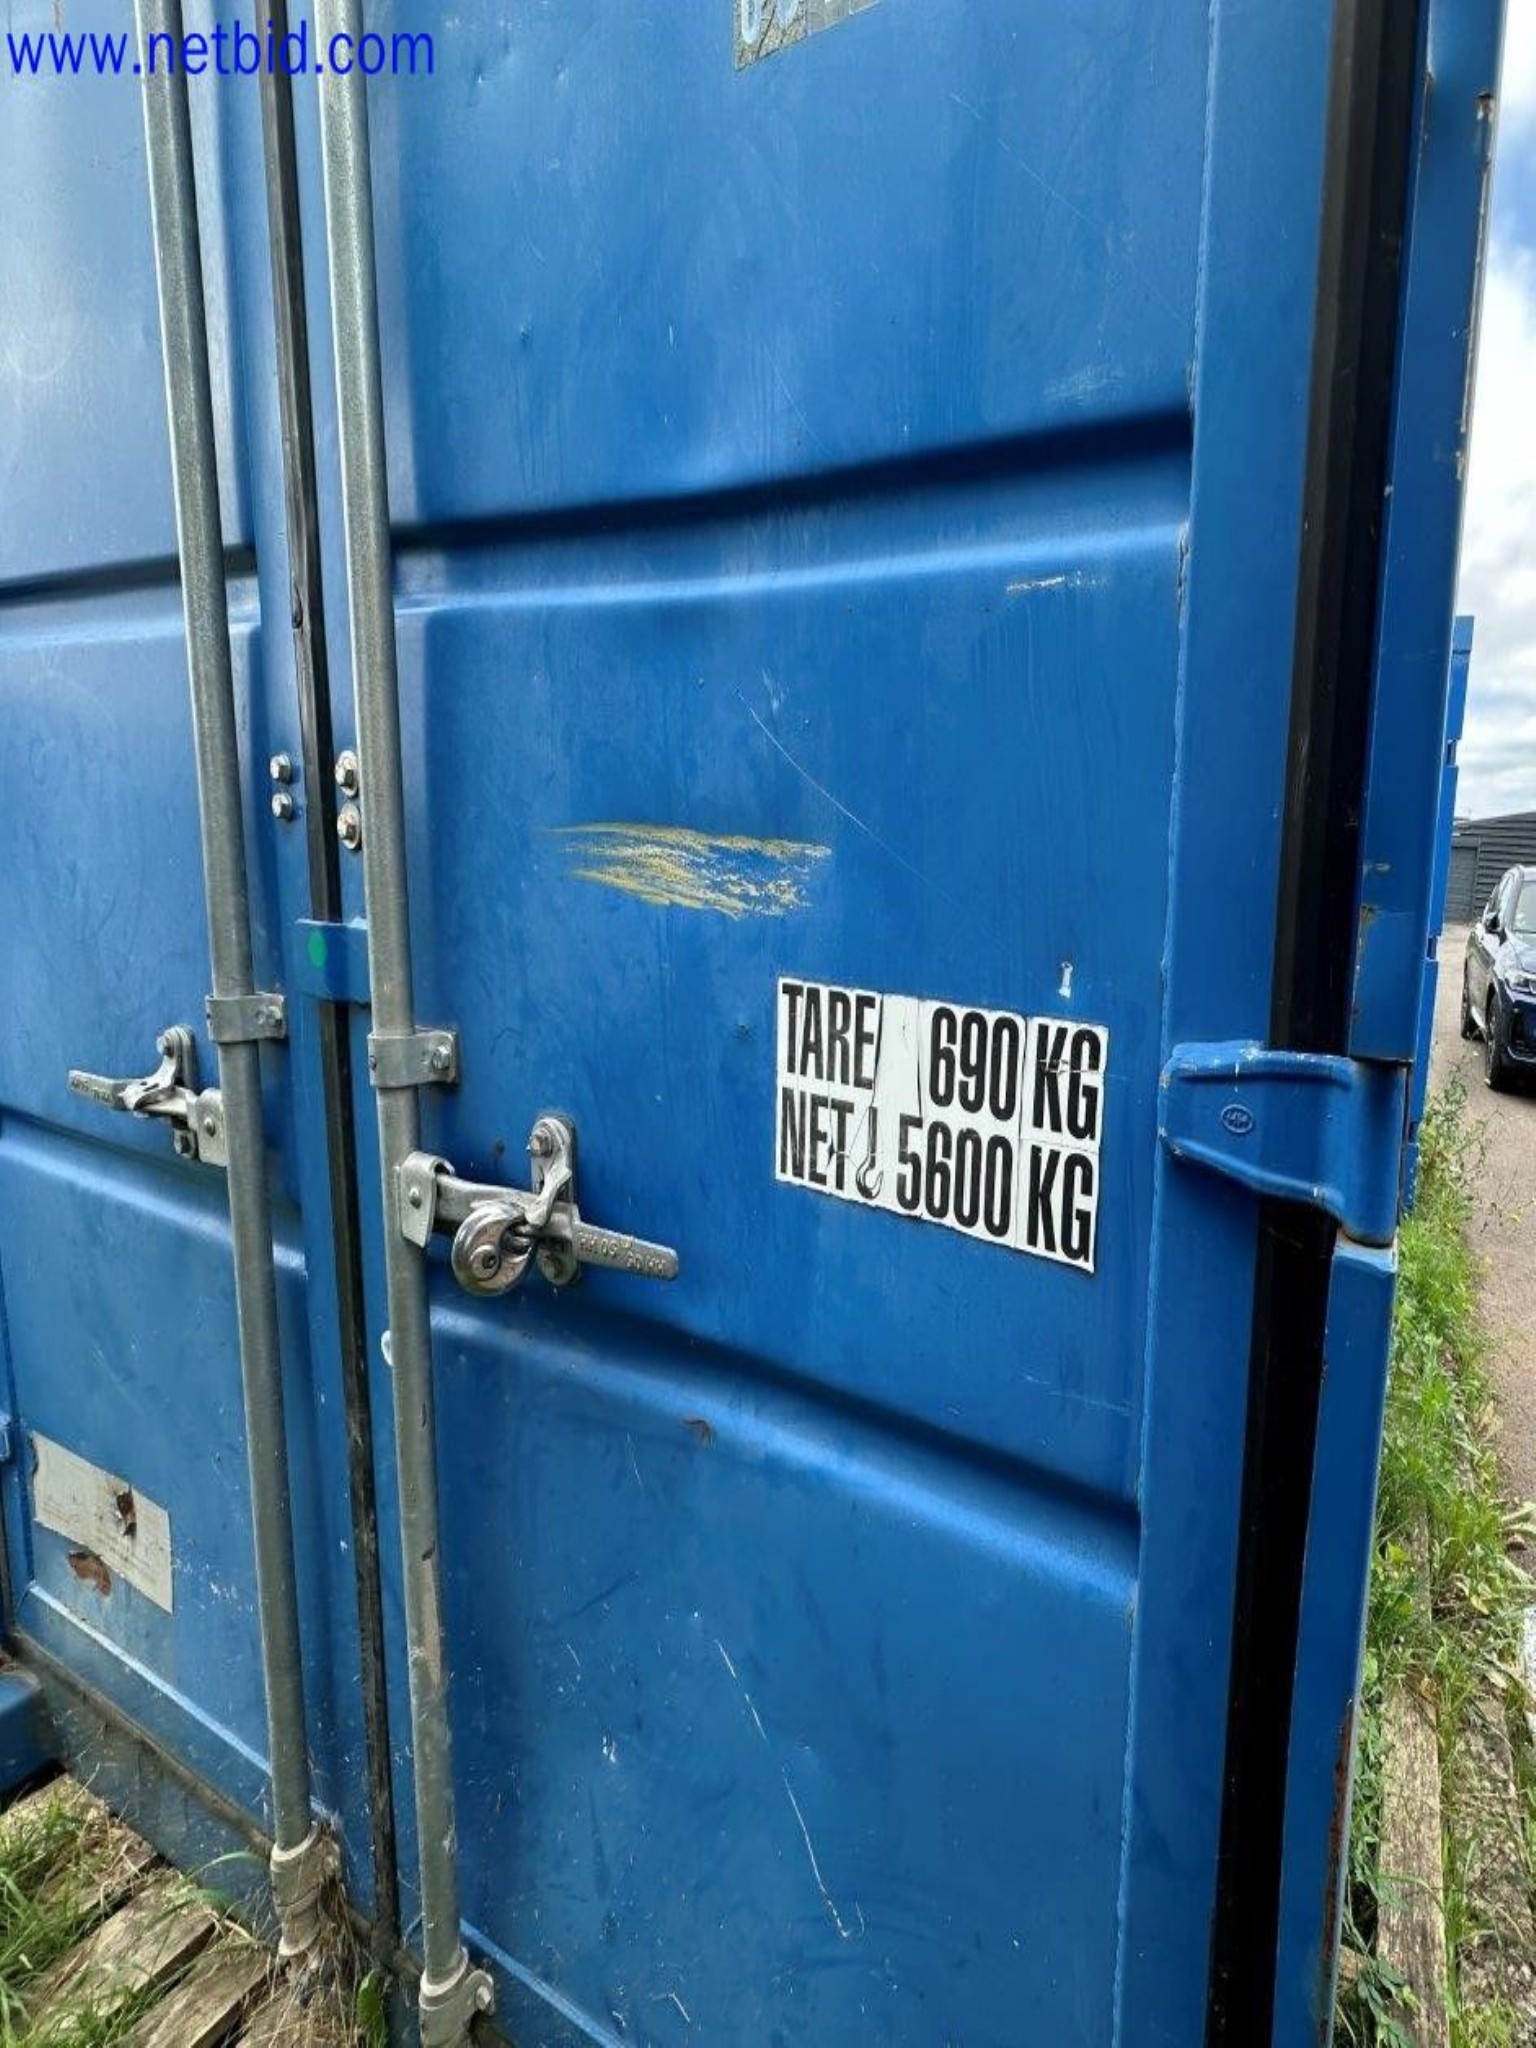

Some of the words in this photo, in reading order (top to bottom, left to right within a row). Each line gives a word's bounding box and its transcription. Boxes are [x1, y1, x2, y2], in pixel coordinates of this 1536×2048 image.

[781, 983, 877, 1090] TARE
[929, 1006, 1020, 1122] 690
[1032, 1022, 1102, 1141] KG
[780, 1087, 855, 1191] NET
[896, 1112, 1014, 1238] 5600
[1026, 1145, 1094, 1263] KG
